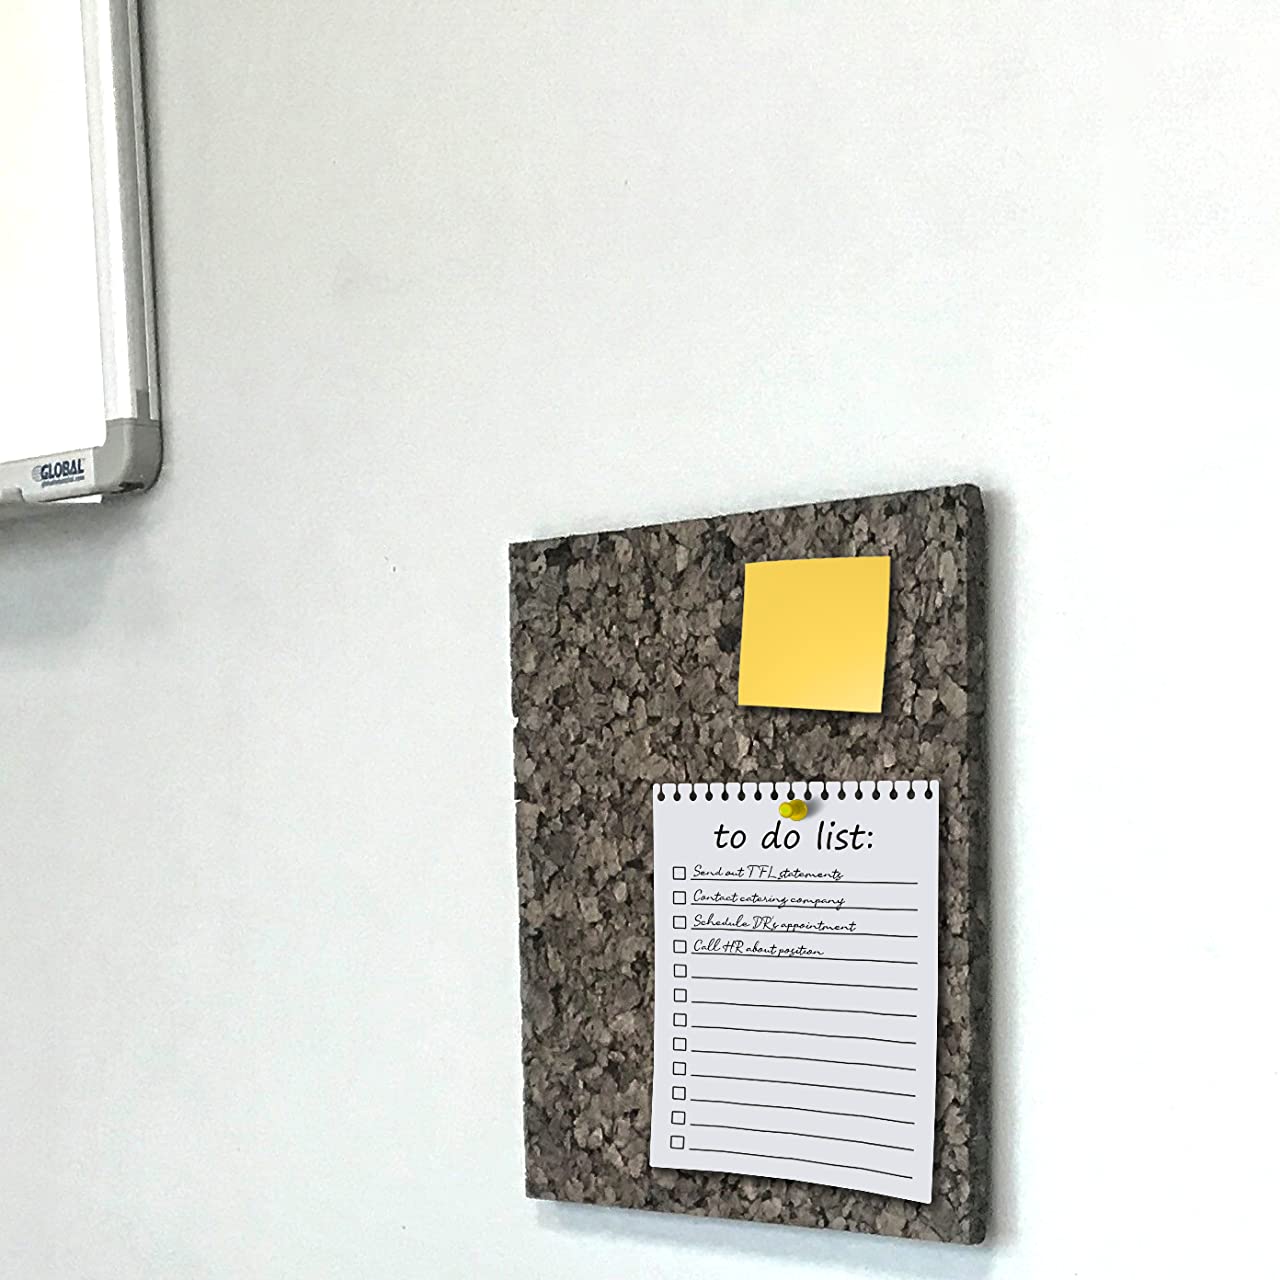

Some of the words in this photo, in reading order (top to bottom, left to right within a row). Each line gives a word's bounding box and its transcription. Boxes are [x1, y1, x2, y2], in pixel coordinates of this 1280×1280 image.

[40, 458, 85, 480] GLOBAL
[713, 823, 747, 849] to
[761, 820, 801, 850] do
[816, 821, 874, 850] list:
[693, 864, 723, 877] Send
[725, 866, 745, 878] out
[746, 864, 777, 879] TFL
[778, 867, 844, 880] statements
[693, 888, 738, 903] Contact
[739, 892, 788, 909] catering
[790, 897, 846, 911] company
[693, 912, 751, 928] Schedule
[780, 920, 857, 933] appointment
[693, 937, 721, 952] Call
[722, 939, 744, 954] HR
[745, 940, 777, 955] about
[776, 945, 824, 958] position
